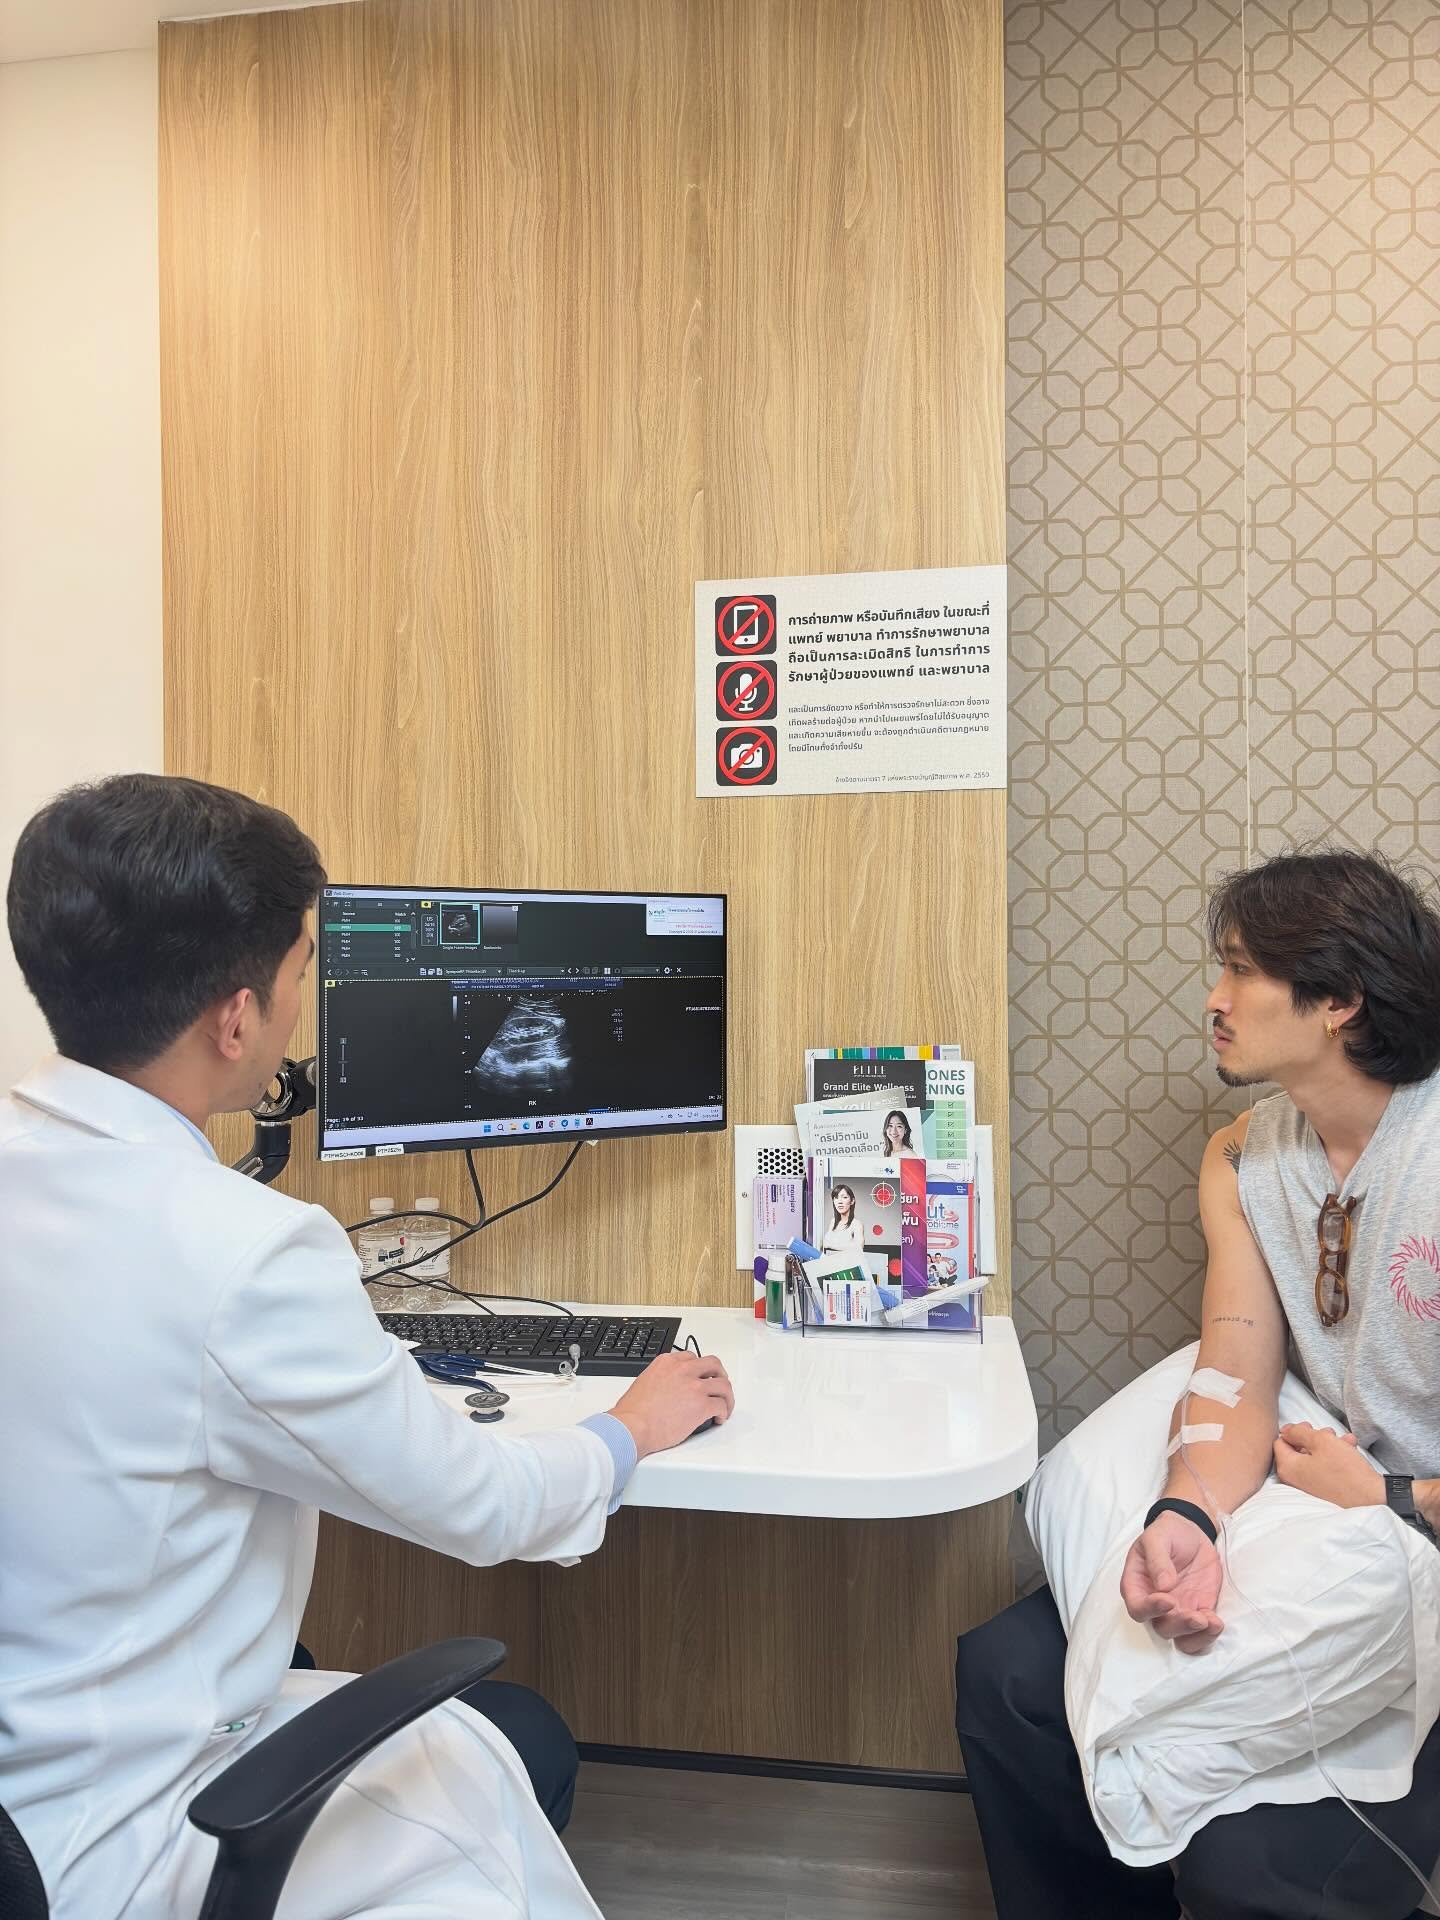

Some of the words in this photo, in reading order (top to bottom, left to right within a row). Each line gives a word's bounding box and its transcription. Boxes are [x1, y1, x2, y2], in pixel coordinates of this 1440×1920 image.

[788, 612, 853, 626] การถ่ายภาพ
[856, 607, 940, 623] หรือบันทึกเสียง
[943, 600, 990, 618] ในขณะที่
[788, 631, 823, 644] แพทย์
[827, 630, 872, 643] พยาบาล
[876, 625, 990, 641] ทำการรักษาพยาบาล
[788, 647, 911, 664] ถือเป็นการละเมิดสิทธิ
[916, 643, 991, 658] ในการทำการ
[788, 665, 914, 684] รักษาผู้ป่วยของแพทย์
[919, 663, 990, 676] และพยาบาล
[823, 1083, 849, 1091] Grand
[852, 1083, 871, 1091] Elite
[926, 1084, 965, 1096] NING
